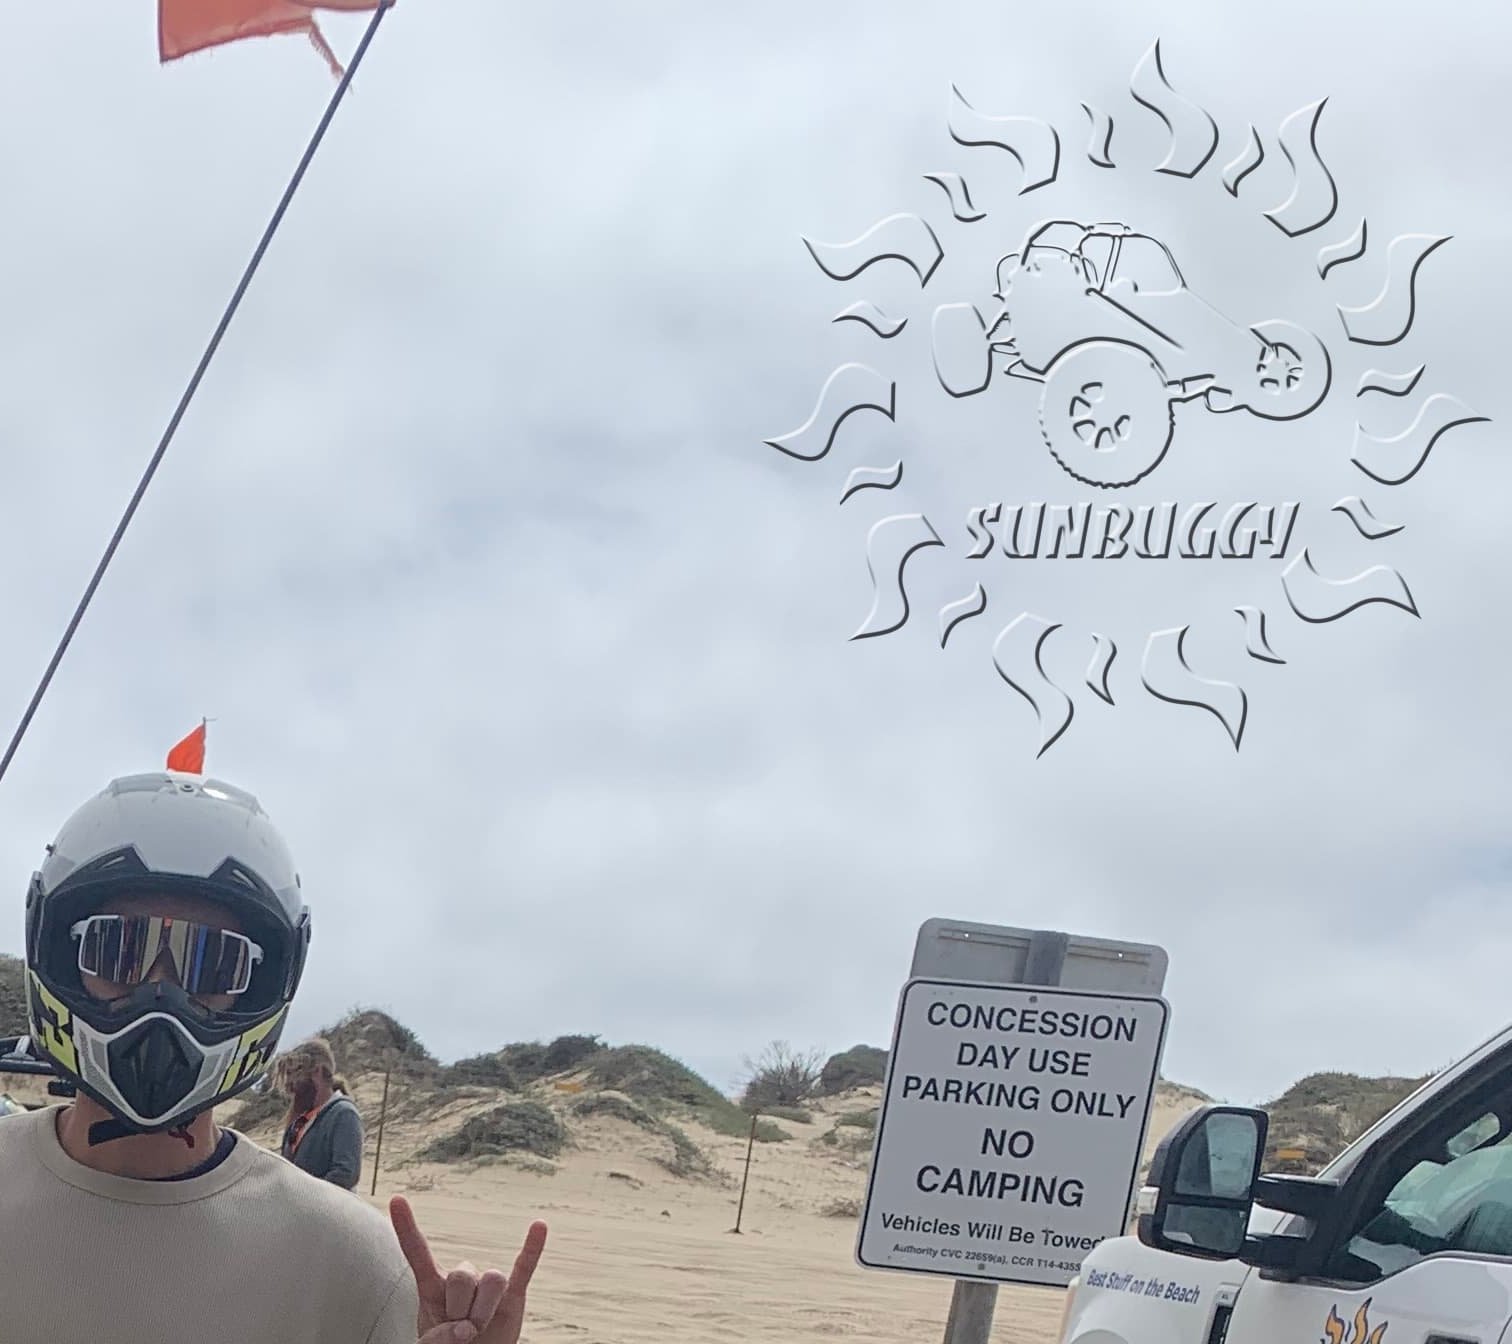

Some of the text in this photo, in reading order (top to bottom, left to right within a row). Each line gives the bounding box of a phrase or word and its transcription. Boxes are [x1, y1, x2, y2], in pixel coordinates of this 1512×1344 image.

[927, 1001, 1137, 1042] CONCESSION
[956, 1042, 1092, 1077] DAY USE
[902, 1075, 1136, 1119] PARKING ONLY
[980, 1127, 1035, 1159] NO
[915, 1164, 1085, 1208] CAMPING
[881, 1212, 961, 1237] Vehicles
[968, 1221, 1003, 1241] Will
[1008, 1226, 1035, 1244] Be
[892, 1242, 939, 1259] Authority
[940, 1248, 963, 1259] CVC
[1011, 1256, 1034, 1268] CCR
[1087, 1269, 1200, 1304] Best Stuff on the Beach
